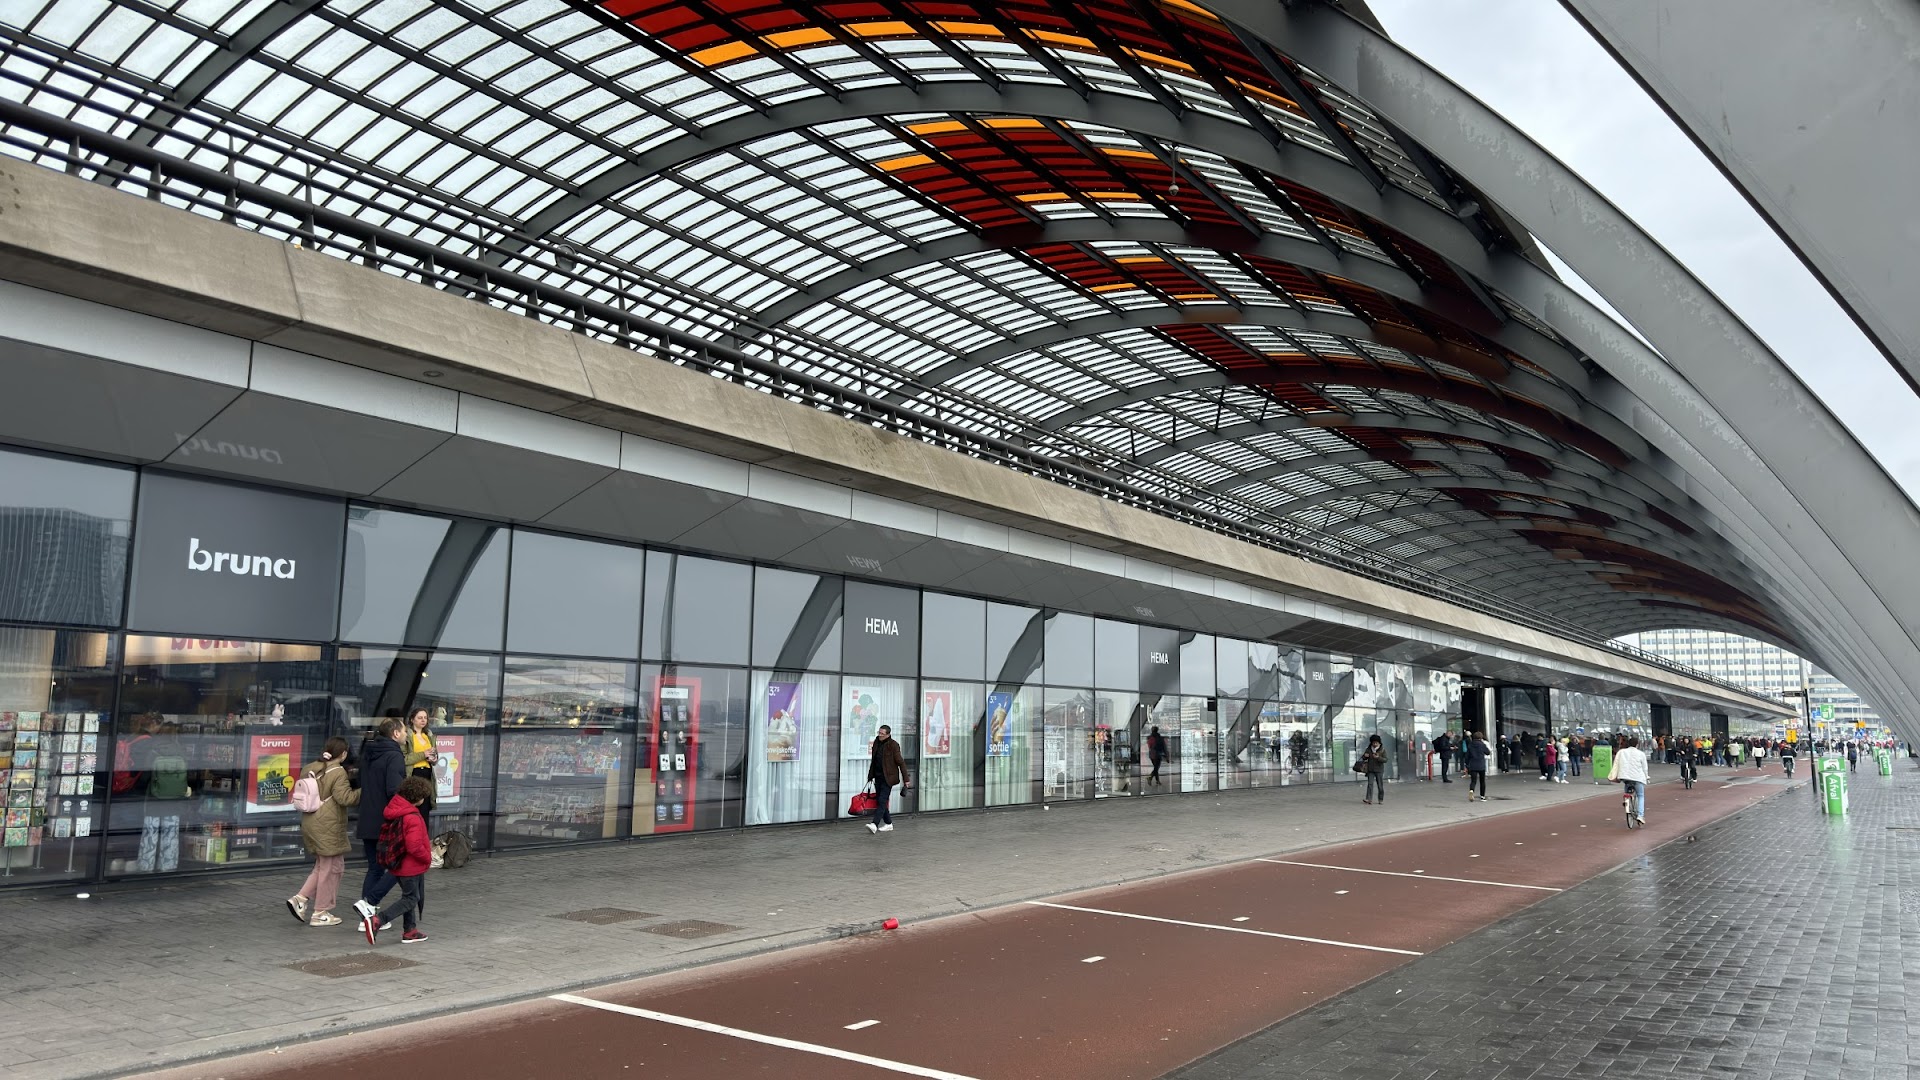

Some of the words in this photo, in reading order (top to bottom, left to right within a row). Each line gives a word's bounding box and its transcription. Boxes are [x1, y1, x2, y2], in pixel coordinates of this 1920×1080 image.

[188, 537, 296, 580] bruna
[865, 617, 899, 636] HEMA
[1150, 651, 1170, 665] HEMA
[261, 738, 290, 748] bruna
[436, 739, 456, 747] runa
[988, 741, 1010, 753] softie
[260, 785, 287, 796] French
[263, 781, 282, 789] Nicci
[1829, 777, 1840, 800] Afval
